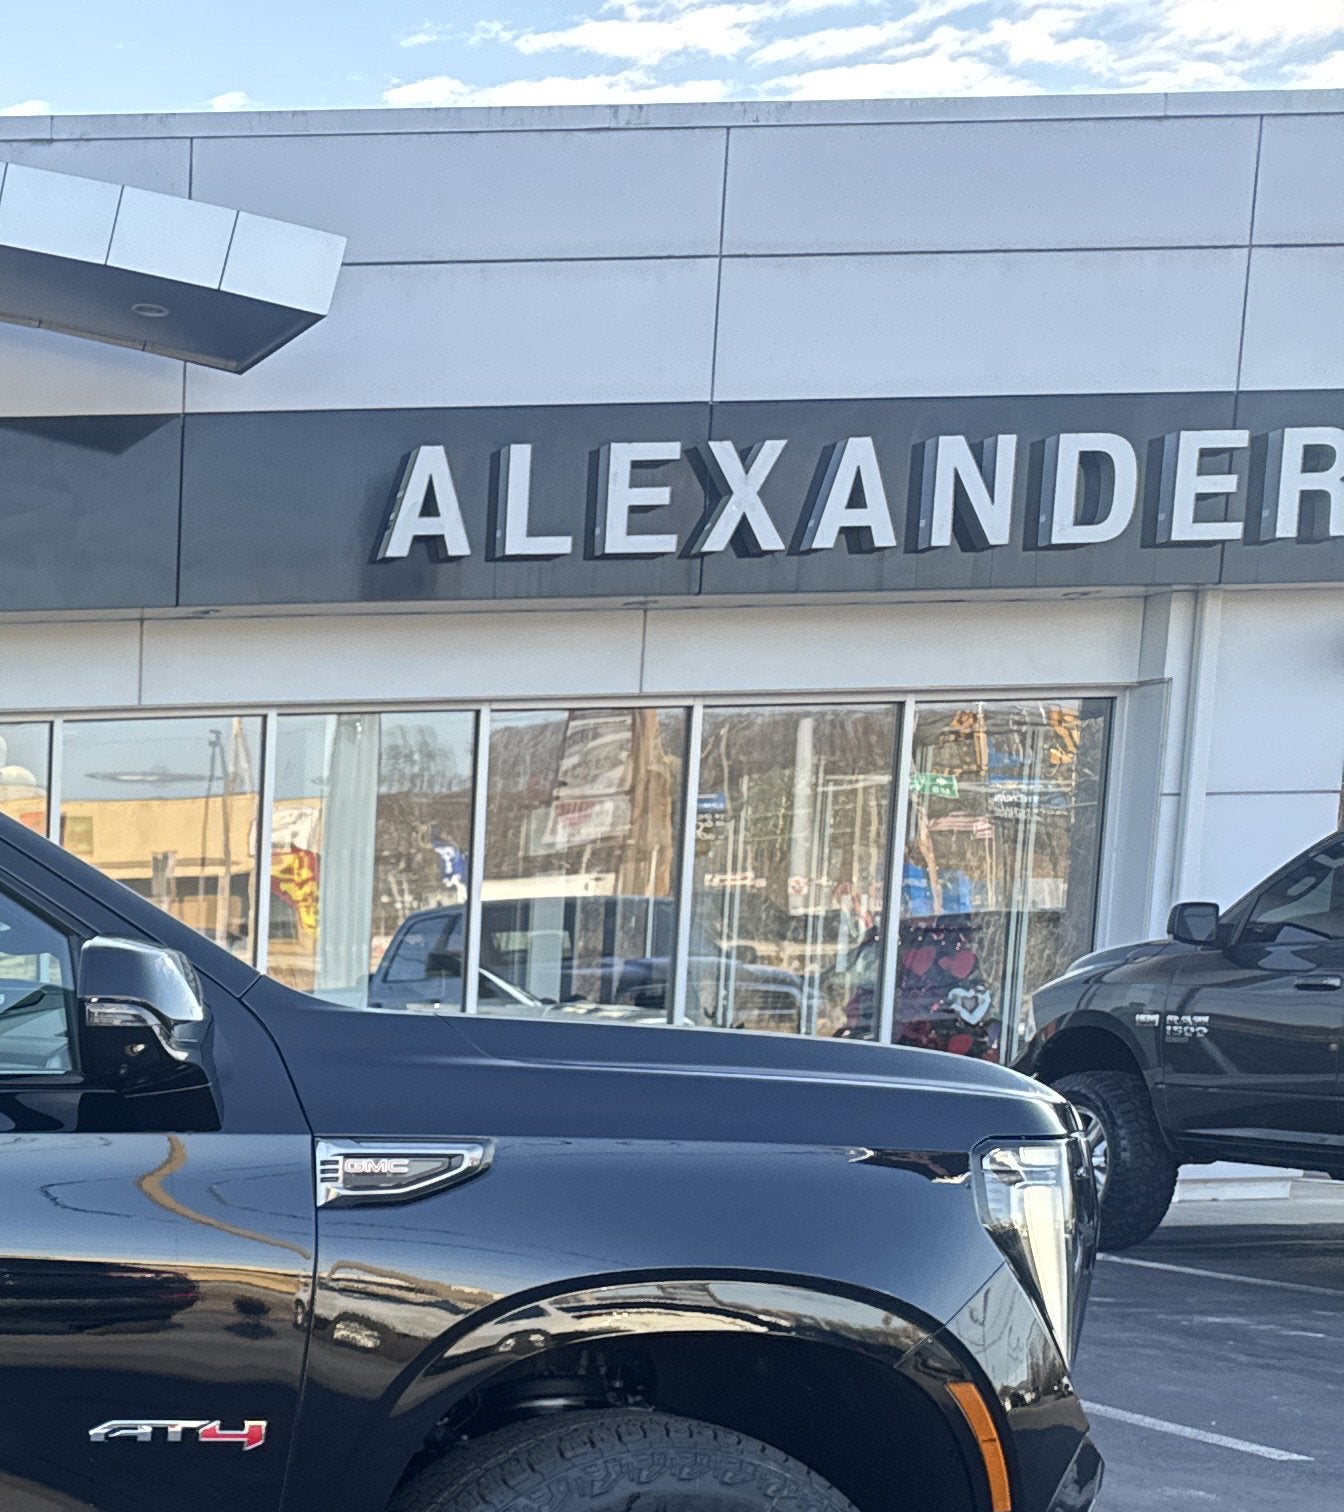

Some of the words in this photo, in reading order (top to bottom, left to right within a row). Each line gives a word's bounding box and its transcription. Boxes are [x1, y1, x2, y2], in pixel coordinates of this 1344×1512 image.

[378, 426, 1344, 559] ALEXANDER
[1165, 1025, 1209, 1038] 1500
[344, 1158, 409, 1173] GMC
[88, 1419, 268, 1451] AT4
